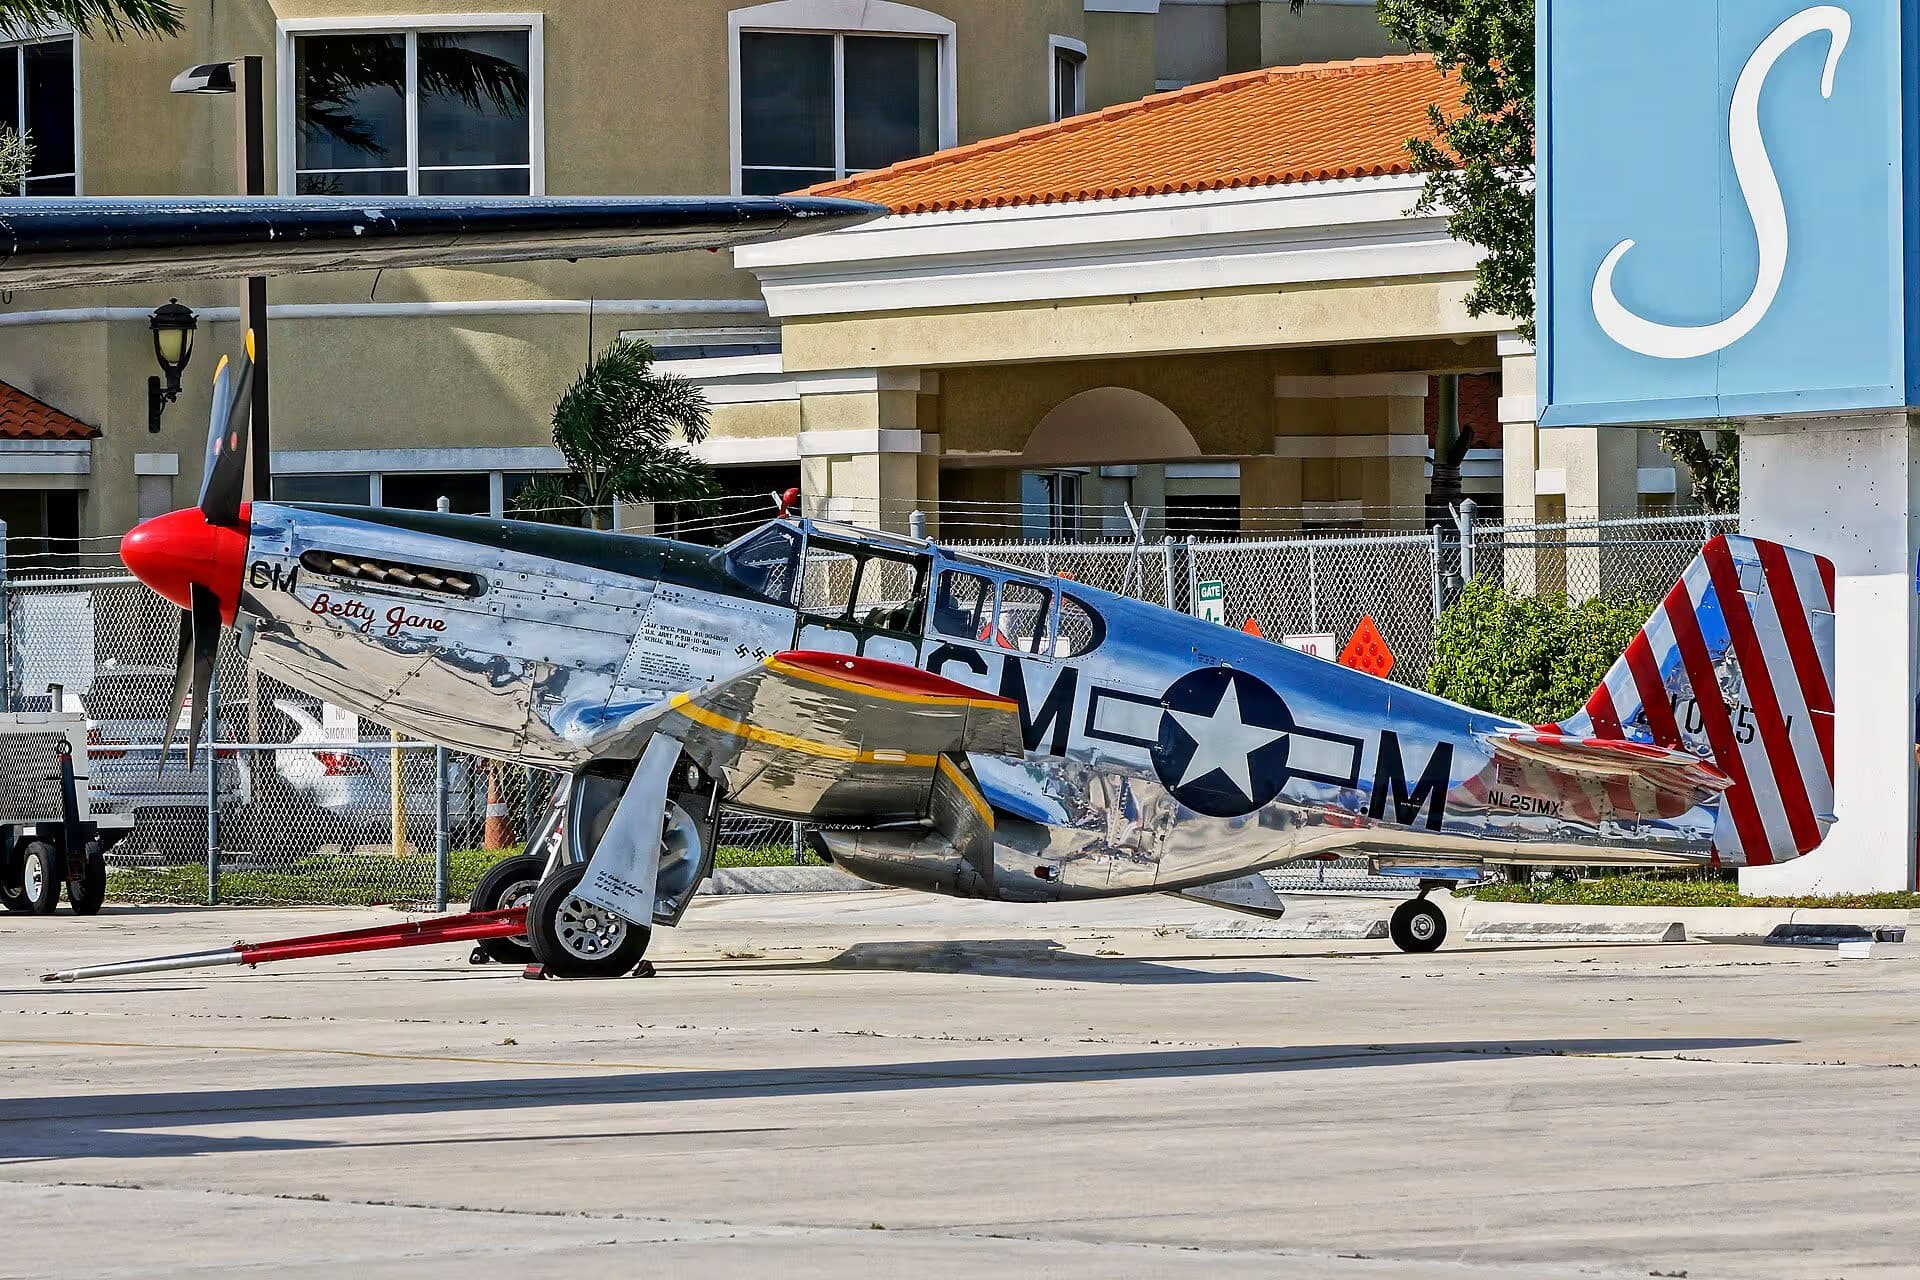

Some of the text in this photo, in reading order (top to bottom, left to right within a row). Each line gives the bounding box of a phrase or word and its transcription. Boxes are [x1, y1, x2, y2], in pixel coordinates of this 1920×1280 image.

[1591, 5, 1851, 358] S
[250, 560, 299, 593] CM
[1201, 585, 1220, 598] GATE
[311, 593, 447, 637] Betty Jane
[335, 707, 346, 720] NO
[325, 727, 357, 740] SMOKING
[1368, 729, 1454, 832] M
[1488, 790, 1560, 816] NL251MX
